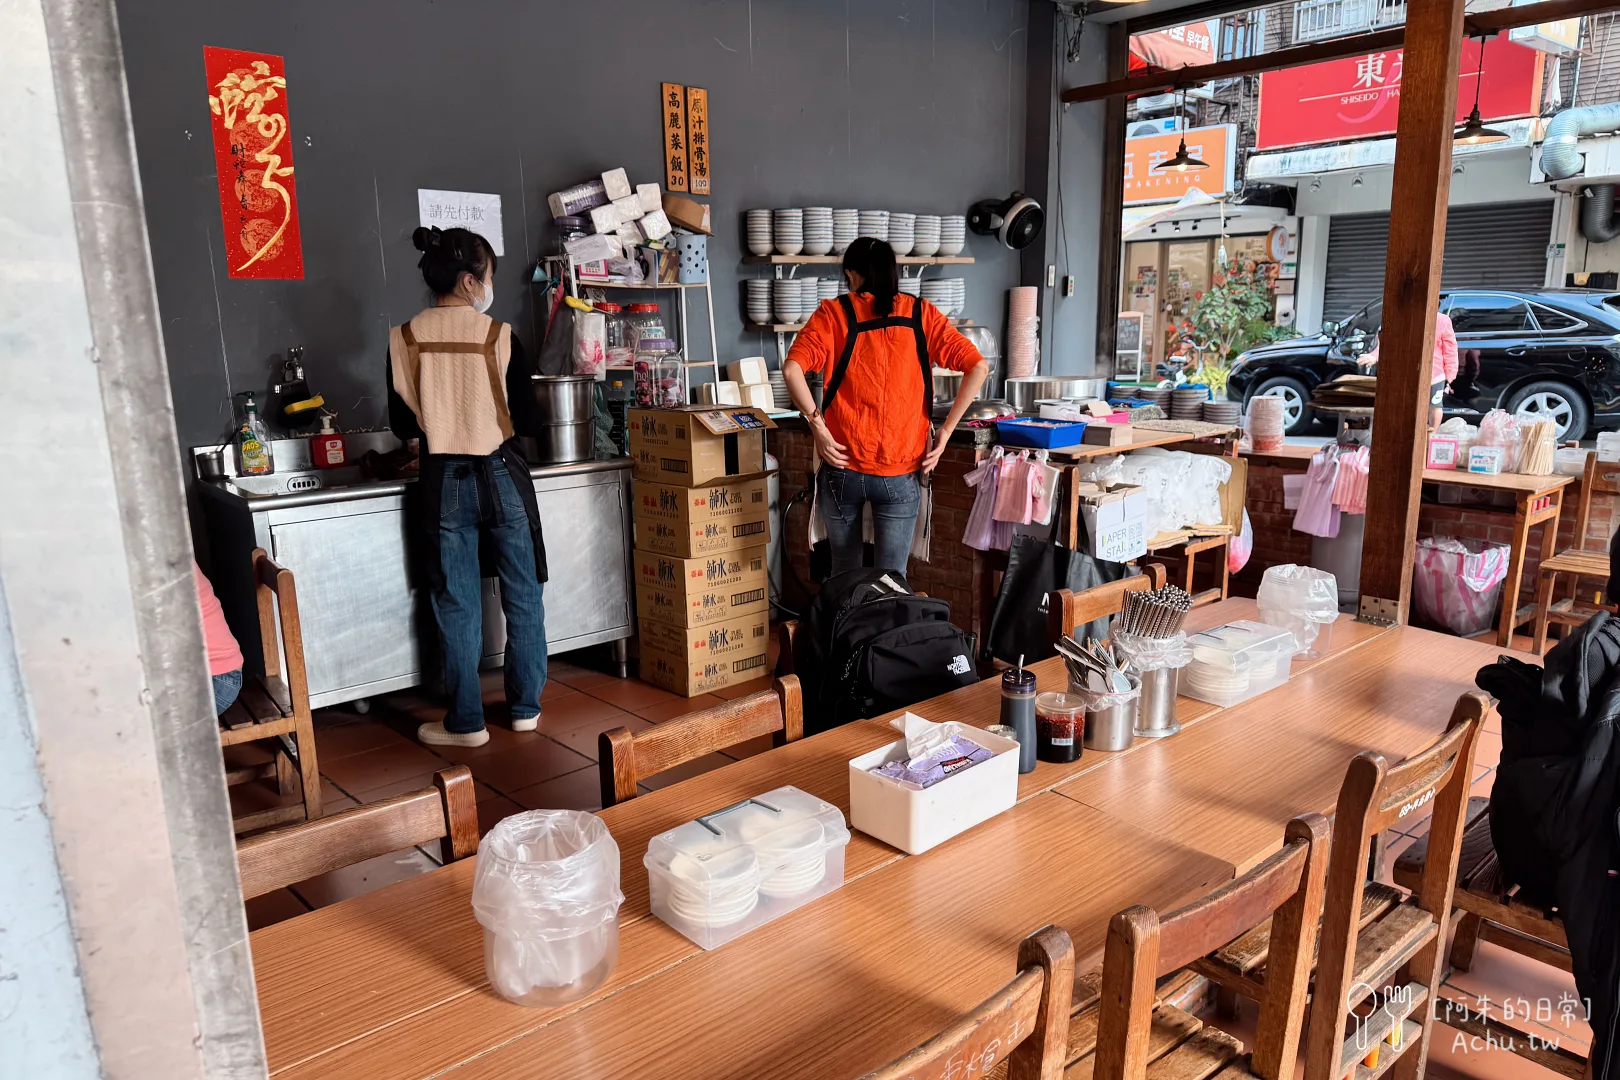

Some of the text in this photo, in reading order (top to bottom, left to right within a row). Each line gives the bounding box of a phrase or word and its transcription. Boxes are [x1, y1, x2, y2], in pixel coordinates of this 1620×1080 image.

[1186, 30, 1210, 51] 早午餐
[1341, 92, 1379, 105] SHISEIDO
[669, 92, 684, 186] 高麗菜飯 30
[691, 98, 707, 177] 原汁排骨湯
[429, 204, 484, 221] 請先付款
